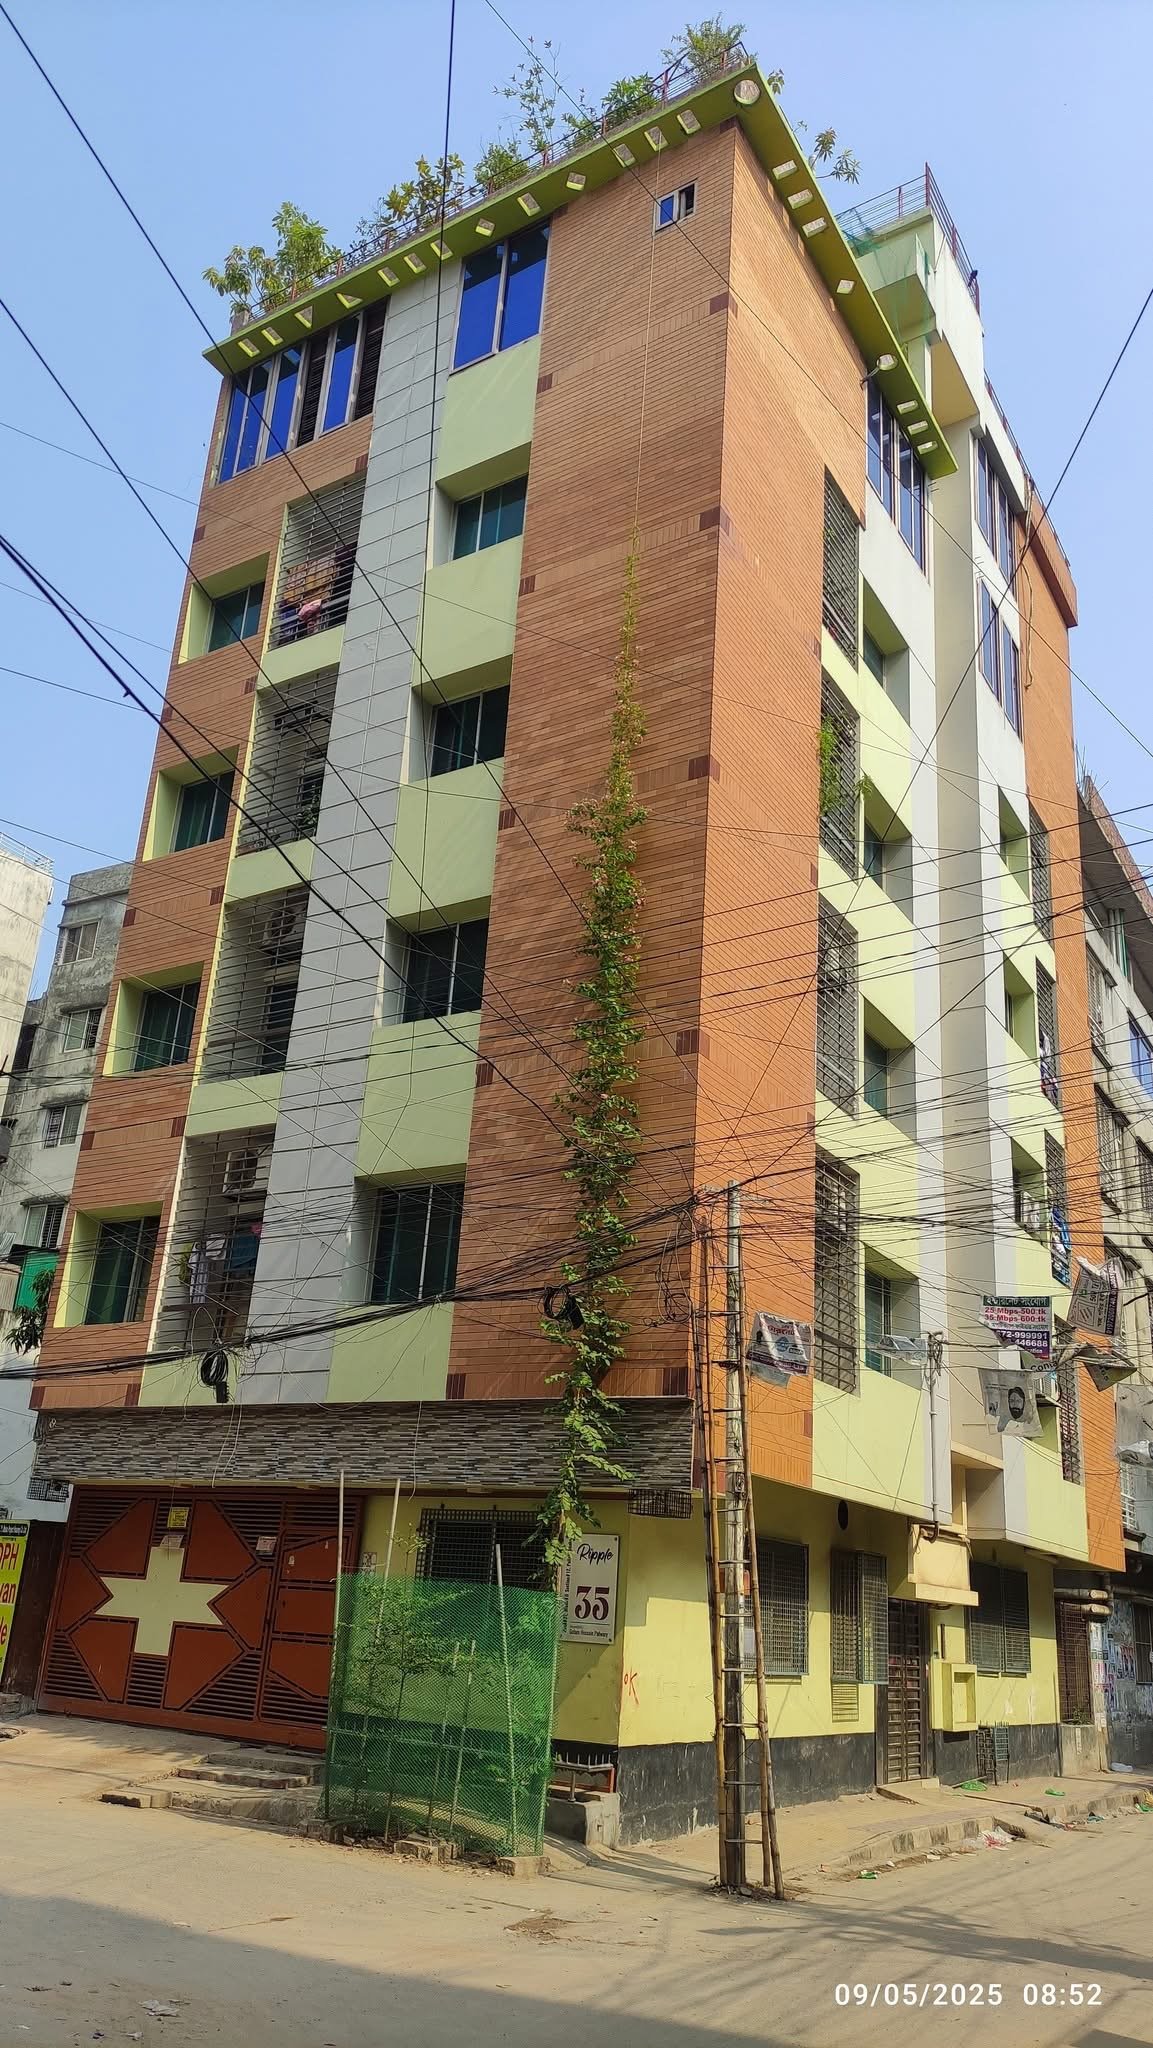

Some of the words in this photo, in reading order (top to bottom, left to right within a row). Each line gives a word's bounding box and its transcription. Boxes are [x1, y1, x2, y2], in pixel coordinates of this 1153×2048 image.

[998, 1330, 1048, 1340] 72-999991
[576, 1543, 614, 1565] Ripple
[575, 1586, 610, 1620] 35
